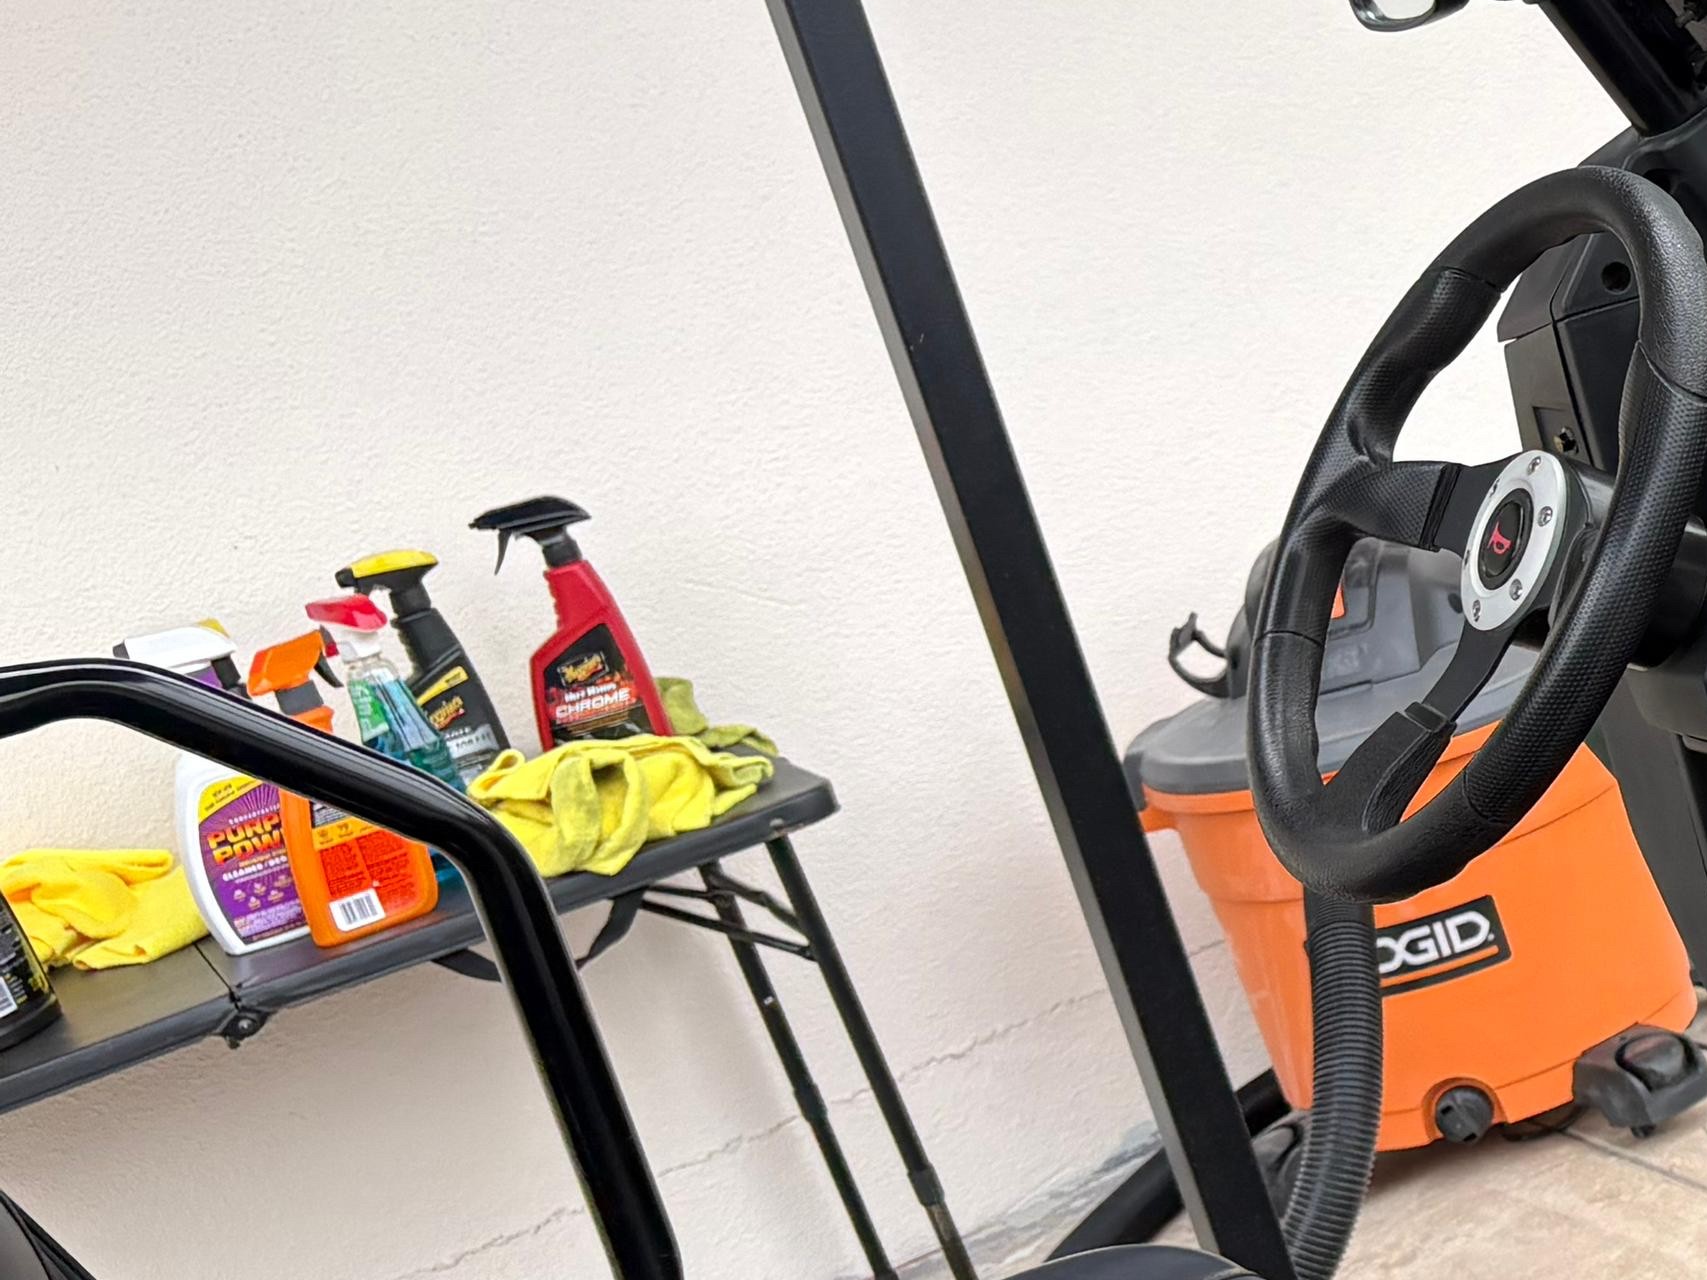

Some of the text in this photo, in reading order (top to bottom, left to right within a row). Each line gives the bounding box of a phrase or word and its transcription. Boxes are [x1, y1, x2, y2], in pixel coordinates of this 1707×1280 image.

[555, 688, 631, 719] CHROME
[206, 813, 281, 850] PURP
[212, 830, 284, 866] POW
[1376, 910, 1496, 974] DGID
